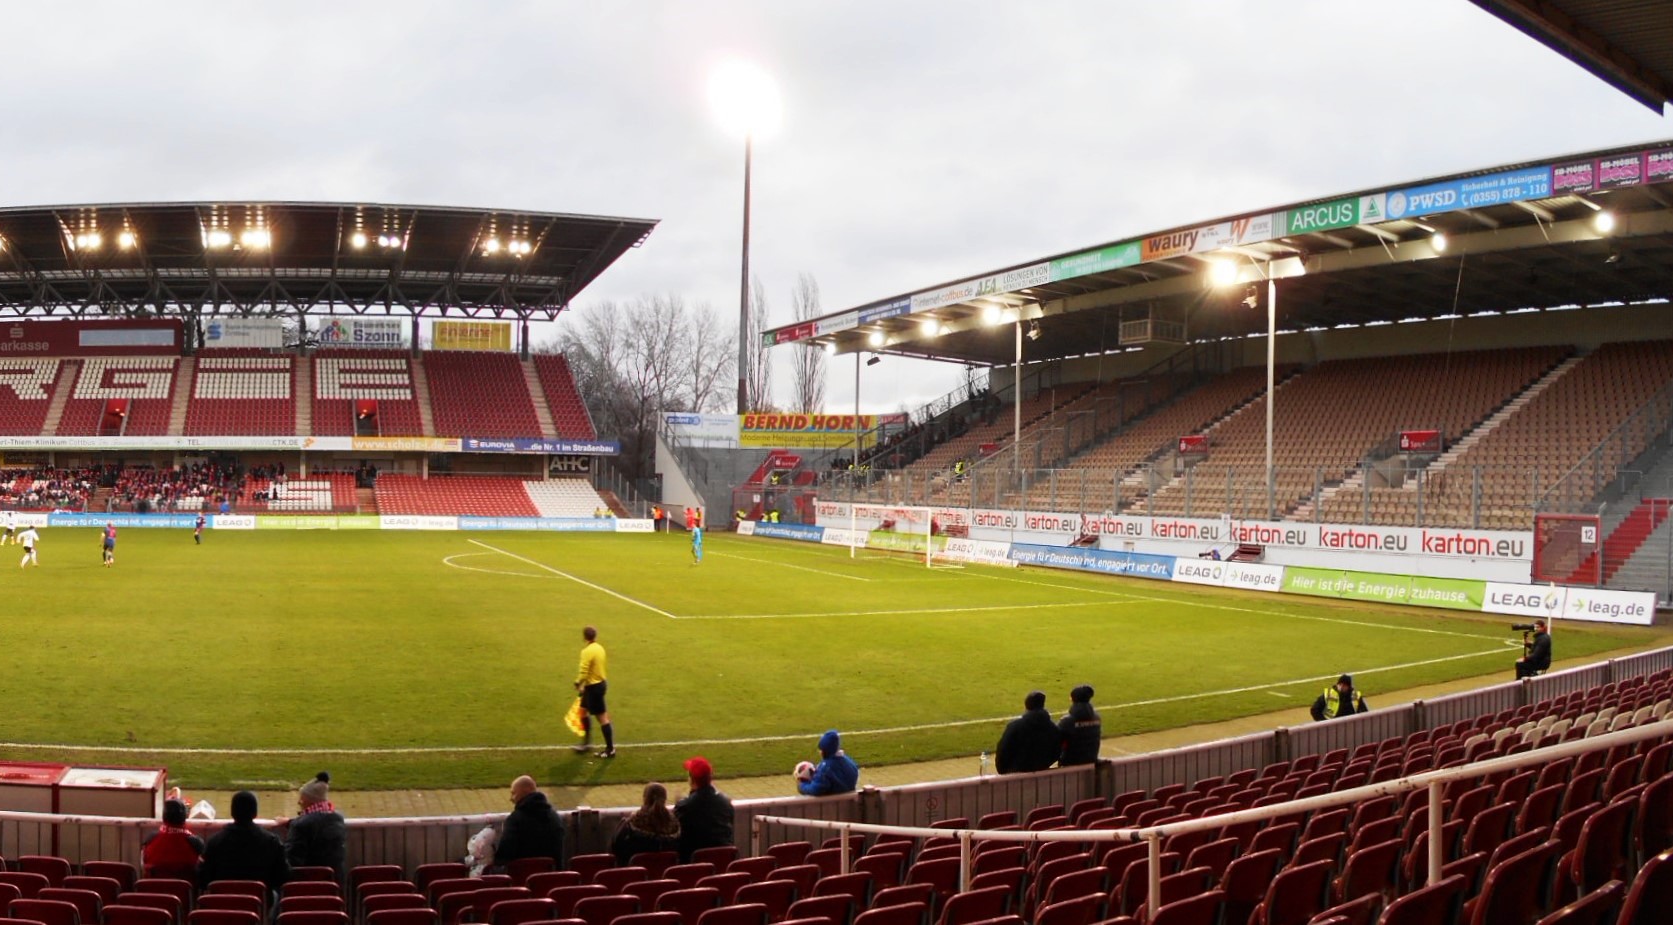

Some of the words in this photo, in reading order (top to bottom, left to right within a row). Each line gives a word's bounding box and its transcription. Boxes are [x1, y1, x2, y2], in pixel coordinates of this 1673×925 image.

[1409, 190, 1456, 210] PWSD
[1470, 191, 1500, 206] (0355)
[1503, 187, 1520, 198] 878
[1529, 183, 1548, 194] 110
[1291, 203, 1352, 231] ARCUS
[1148, 229, 1199, 254] waury
[353, 330, 400, 342] Szonn
[744, 415, 808, 430] BERND
[812, 415, 871, 430] HORN
[572, 444, 614, 452] Straßenbau
[550, 456, 589, 471] AHC
[51, 518, 78, 526] Energie
[972, 510, 1018, 528] karton.eu
[1024, 513, 1076, 531] karton.eu
[1082, 516, 1143, 536] karton.eu
[1151, 518, 1218, 540] karton.eu
[1230, 522, 1306, 546] karton.eu
[1319, 526, 1407, 551] karton.eu
[1422, 530, 1524, 556] karton.eu
[1584, 530, 1594, 540] 12
[948, 544, 966, 552] LEAG
[984, 548, 1006, 557] leag.de
[1012, 550, 1036, 561] Energie
[1098, 558, 1135, 571] engagiert
[1136, 564, 1149, 572] vor
[1151, 563, 1167, 574] Ort.
[1178, 566, 1211, 578] LEAG
[1240, 572, 1276, 585] leag.de
[1292, 576, 1315, 588] Hier
[1318, 578, 1334, 590] ist
[1358, 582, 1406, 597] Energie
[1412, 586, 1469, 602] zuhause.
[1491, 592, 1541, 608] LEAG
[1588, 600, 1645, 617] leag.de
